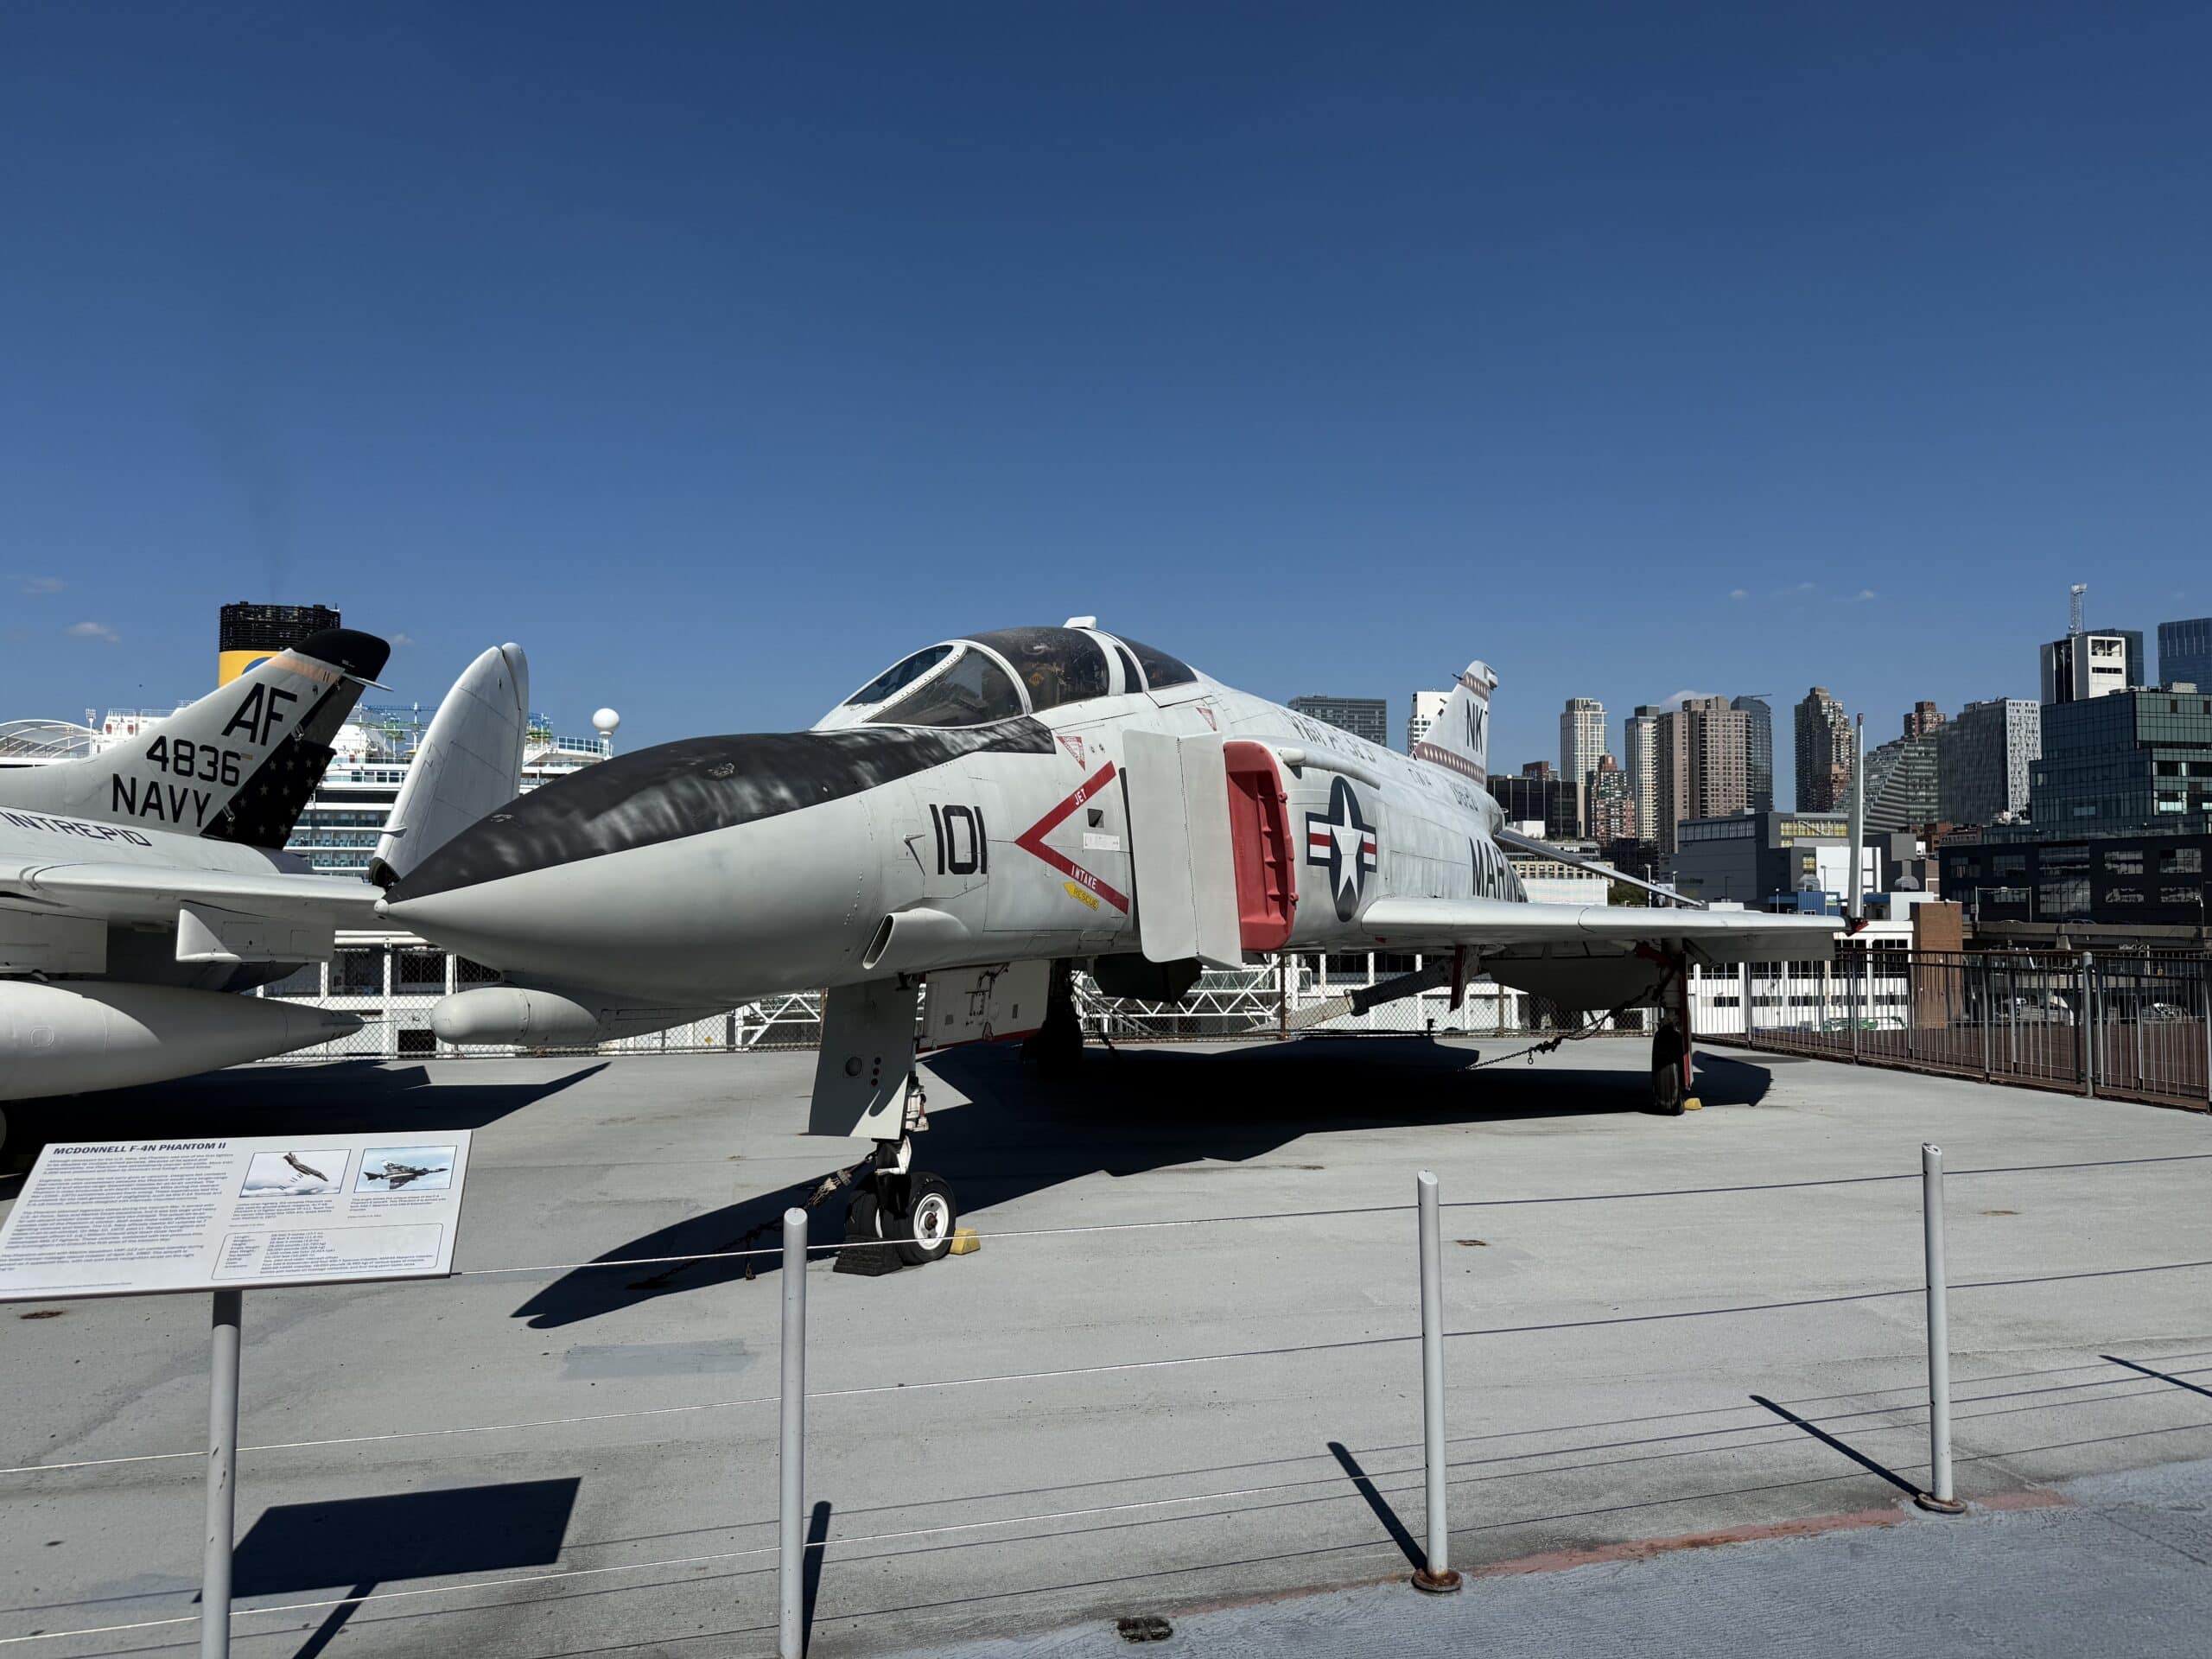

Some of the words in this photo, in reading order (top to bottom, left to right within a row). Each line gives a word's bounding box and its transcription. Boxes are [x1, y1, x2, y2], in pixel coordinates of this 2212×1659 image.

[221, 682, 298, 747] AF
[1466, 698, 1484, 756] NK
[146, 734, 241, 788] 4836
[112, 773, 212, 828] NAVY
[1074, 787, 1088, 805] JET
[0, 811, 153, 847] INTREPID
[929, 804, 988, 875] 101
[1071, 864, 1098, 890] INTAKE
[1072, 887, 1100, 909] RESCUE
[54, 1145, 127, 1155] MCDONNELL
[129, 1144, 157, 1154] F-4N
[158, 1142, 217, 1152] PHANTOM
[218, 1141, 226, 1150] II
